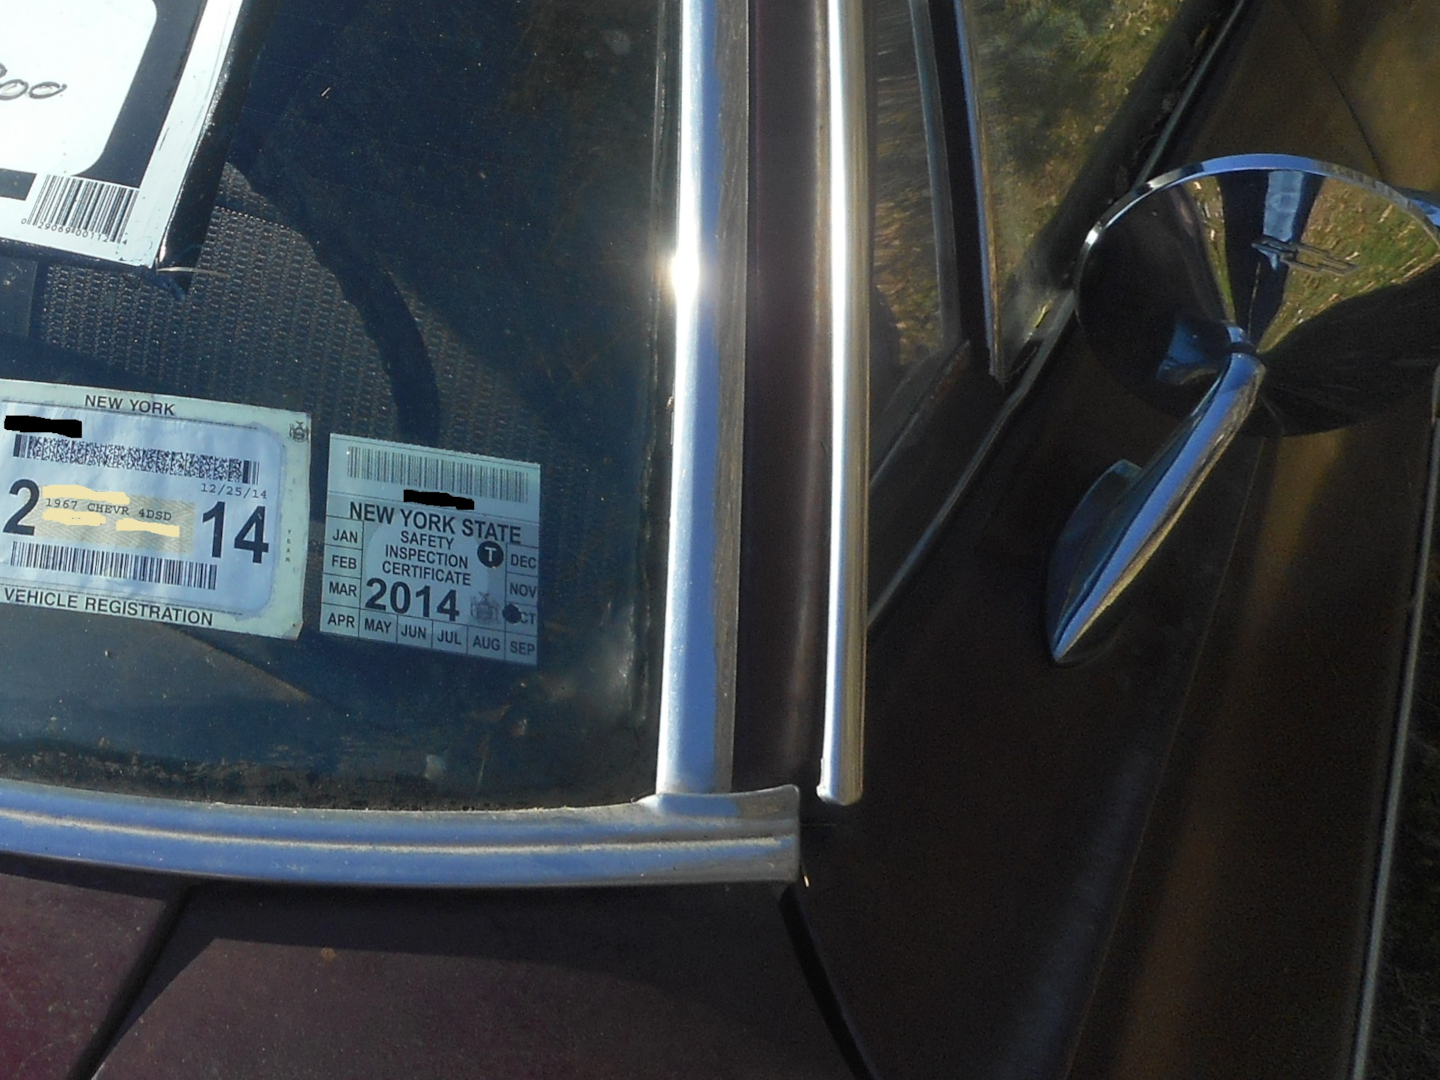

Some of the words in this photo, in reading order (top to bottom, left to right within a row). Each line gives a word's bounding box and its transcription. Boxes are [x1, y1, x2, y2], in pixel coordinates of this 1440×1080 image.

[85, 394, 124, 410] NEW
[129, 399, 176, 416] YORK
[200, 482, 268, 500] 12/25/14
[45, 497, 79, 510] 1967
[87, 502, 130, 516] CHEVR
[138, 507, 173, 521] 4DSD
[349, 501, 395, 525] NEW
[400, 508, 456, 535] YORK
[461, 519, 522, 544] STATE
[202, 500, 270, 564] 14
[332, 529, 359, 544] JAN
[400, 530, 455, 550] SAFETY
[331, 554, 358, 570] FEB
[385, 545, 468, 569] INSPECTION
[484, 546, 498, 564] T
[510, 553, 537, 570] DEC
[382, 560, 471, 586] CERTIFICATE
[328, 581, 358, 598] MAR
[510, 582, 537, 599] NOV
[4, 587, 79, 609] VEHICLE
[84, 596, 214, 627] REGISTRATION
[364, 576, 460, 622] 2014
[327, 612, 356, 629] APR
[364, 617, 393, 634] MAY
[400, 624, 427, 640] JUN
[437, 629, 463, 646] JUL
[472, 635, 501, 652] AUG
[510, 640, 536, 657] SEP
